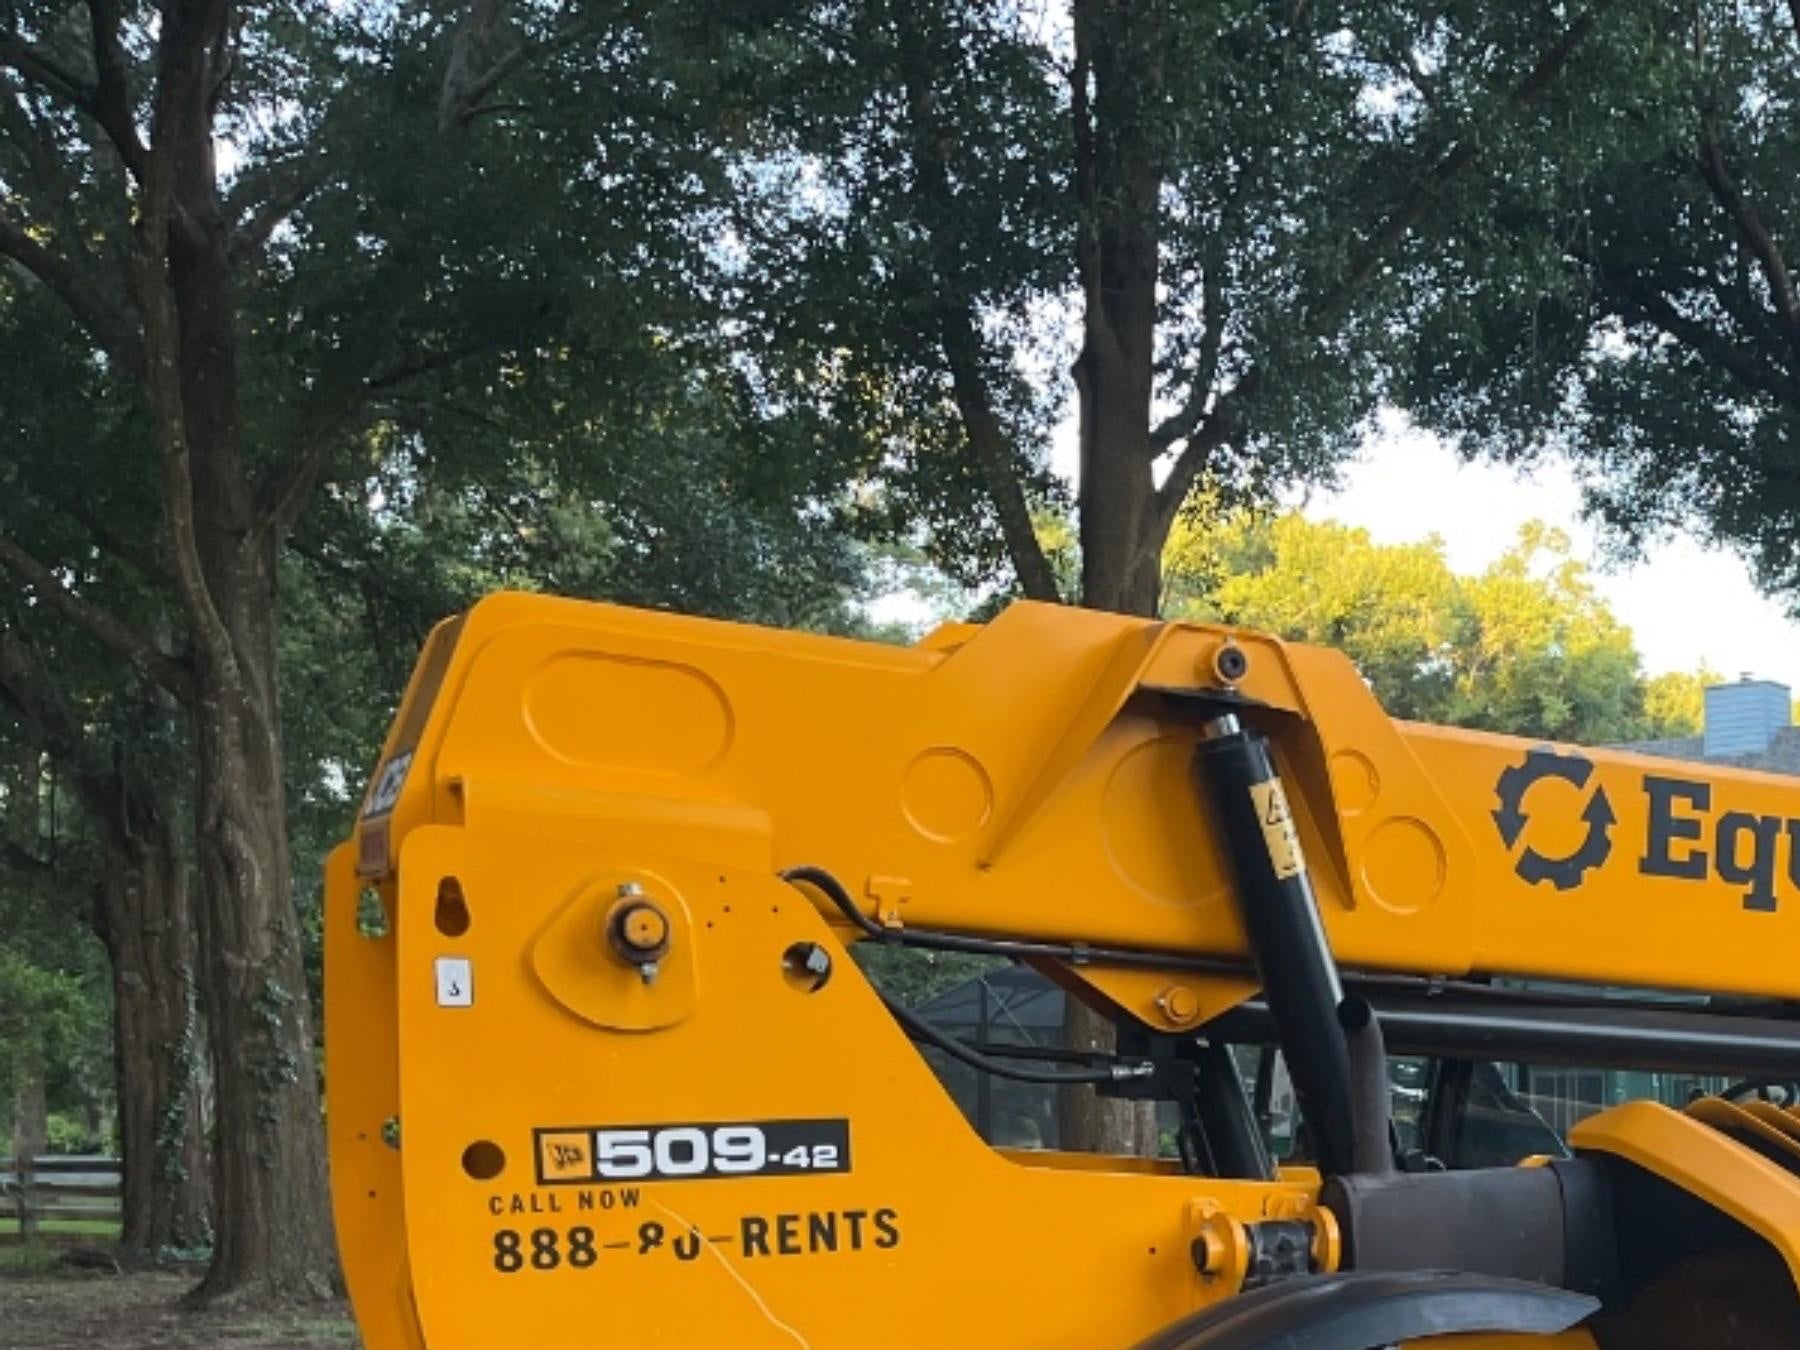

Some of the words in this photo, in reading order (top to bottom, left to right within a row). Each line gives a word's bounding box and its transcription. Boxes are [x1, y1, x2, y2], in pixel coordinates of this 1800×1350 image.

[596, 1126, 839, 1178] 509-42
[488, 1193, 563, 1215] CALL
[578, 1187, 641, 1211] NOW
